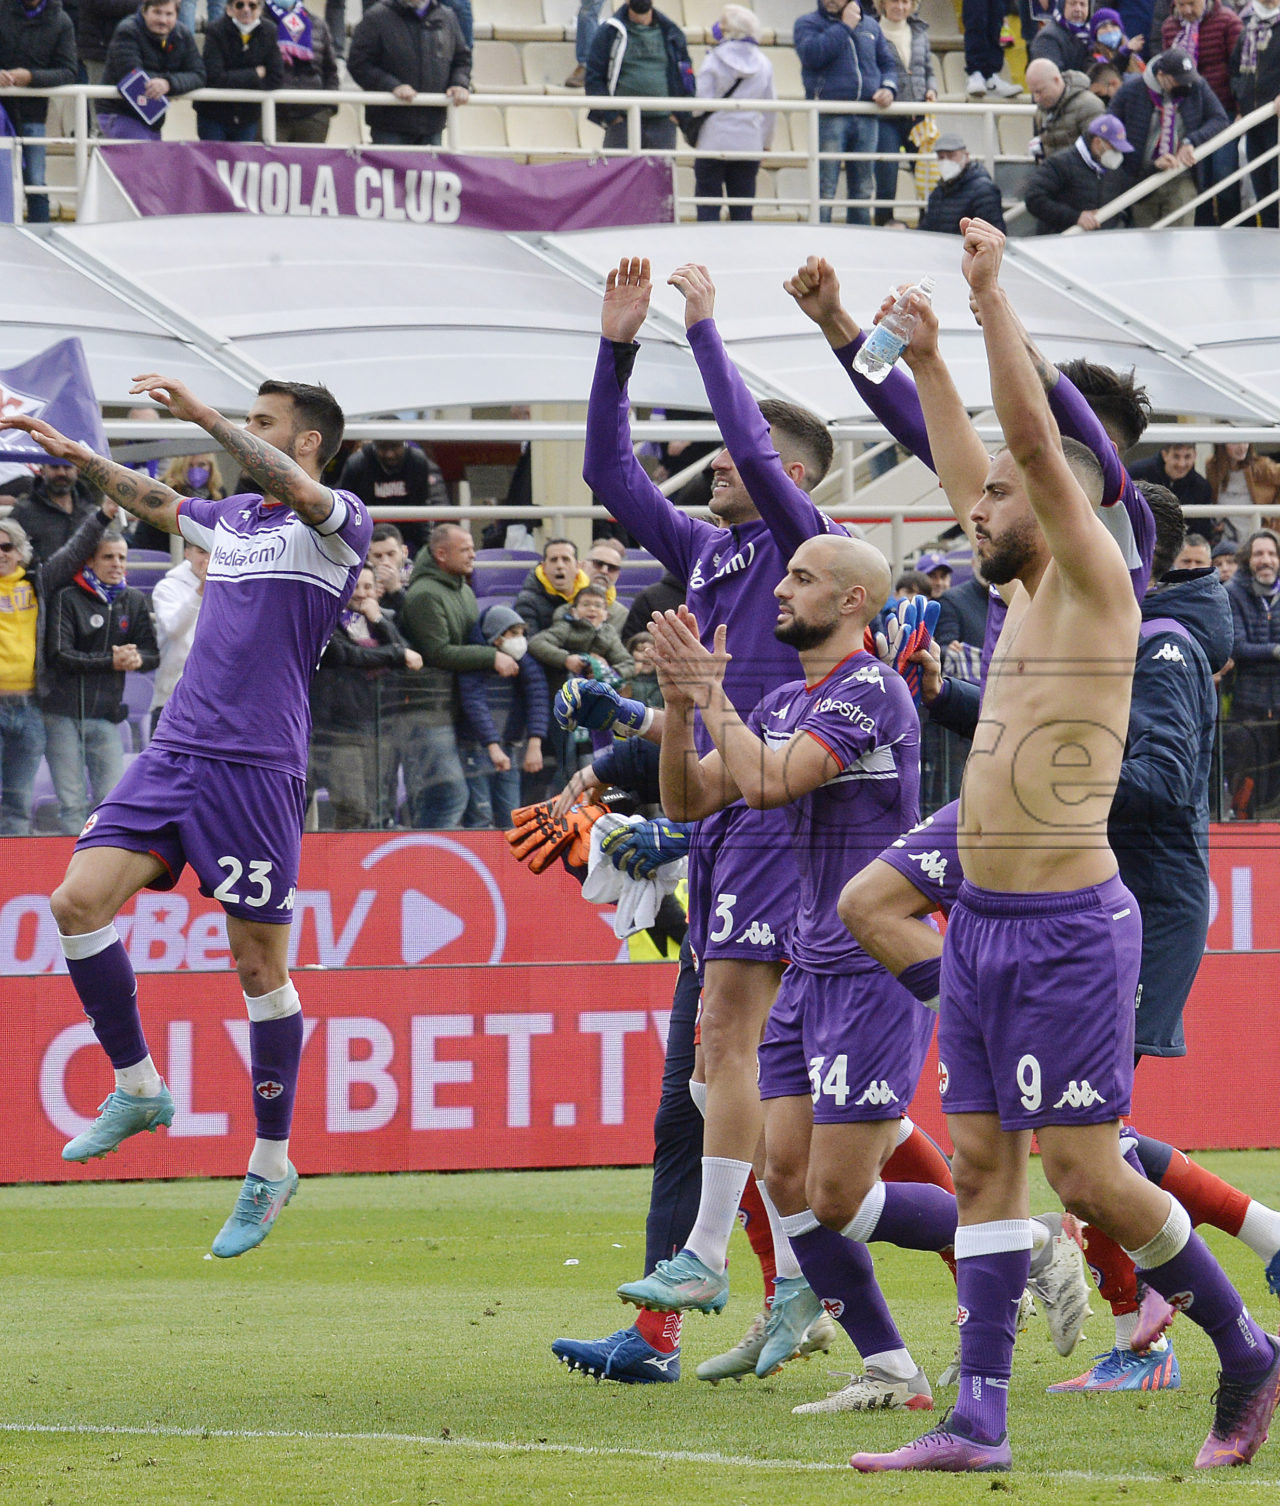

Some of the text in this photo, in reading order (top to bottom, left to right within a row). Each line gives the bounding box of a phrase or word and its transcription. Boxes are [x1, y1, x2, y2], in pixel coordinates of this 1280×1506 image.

[216, 159, 462, 225] VIOLA CLUB
[213, 545, 276, 567] Mediaom
[213, 855, 273, 908] 23
[710, 893, 737, 943] 3
[809, 1053, 850, 1106] 34
[1016, 1053, 1042, 1112] 9
